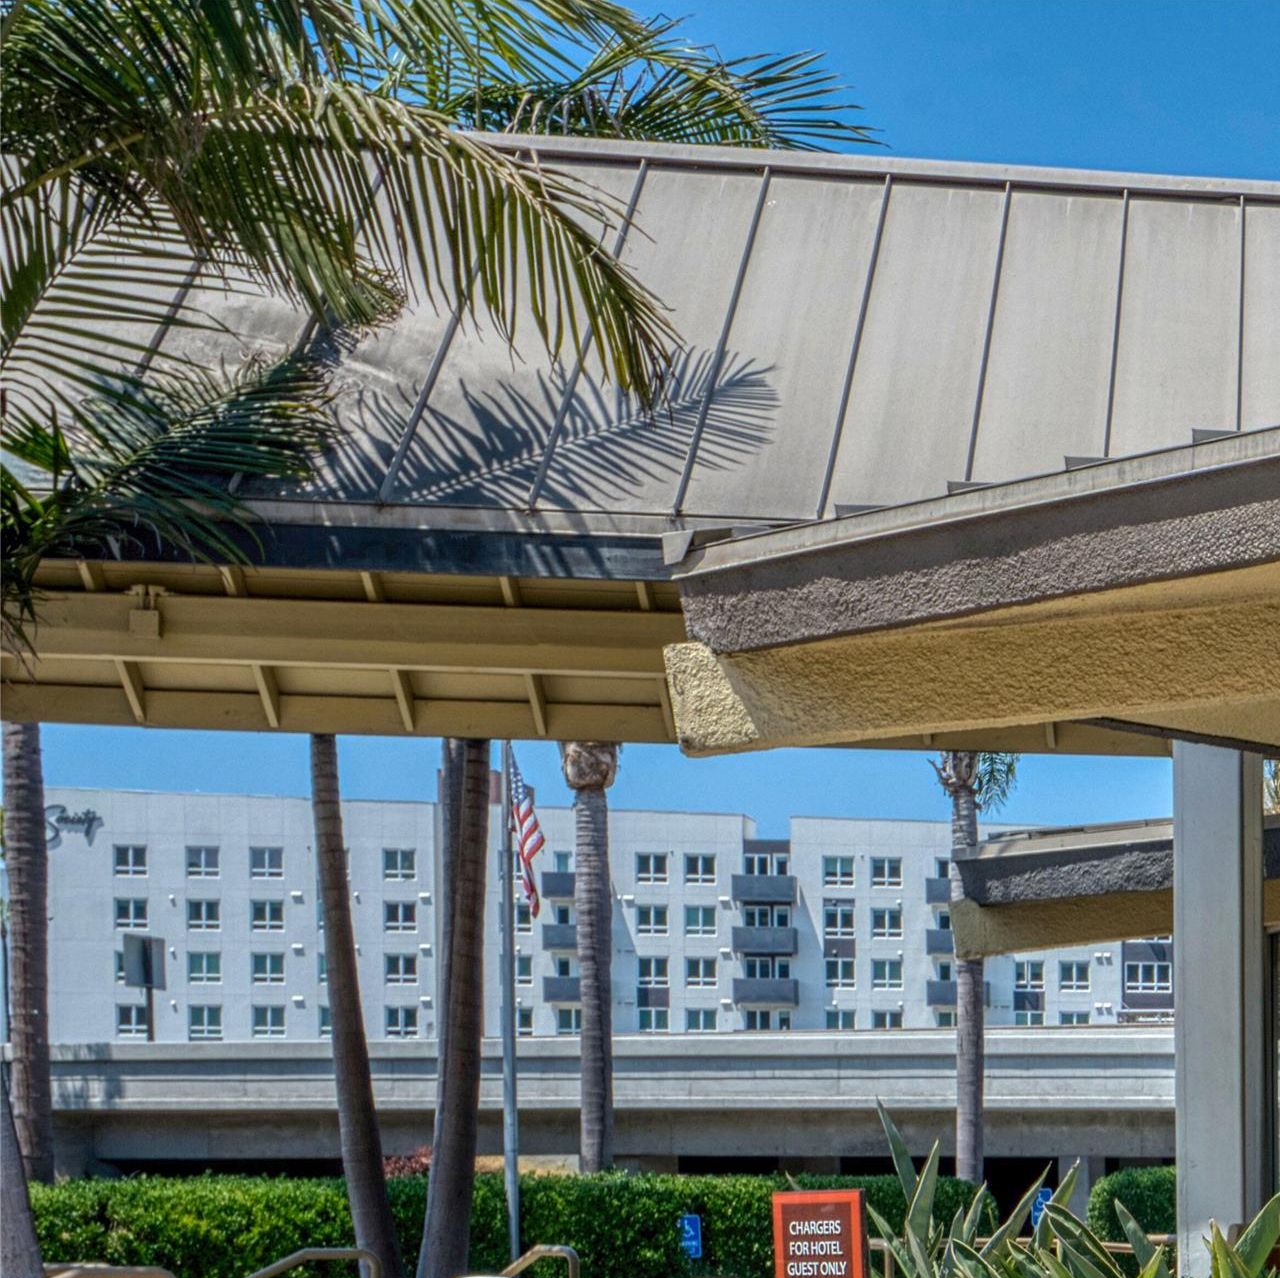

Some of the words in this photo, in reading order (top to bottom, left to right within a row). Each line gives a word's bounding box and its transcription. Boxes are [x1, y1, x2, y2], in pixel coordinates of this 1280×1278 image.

[789, 1219, 842, 1236] CHARGERS
[789, 1241, 810, 1256] FOR
[810, 1241, 844, 1256] HOTEL
[787, 1261, 820, 1277] GUEST
[820, 1261, 847, 1276] ONLY
